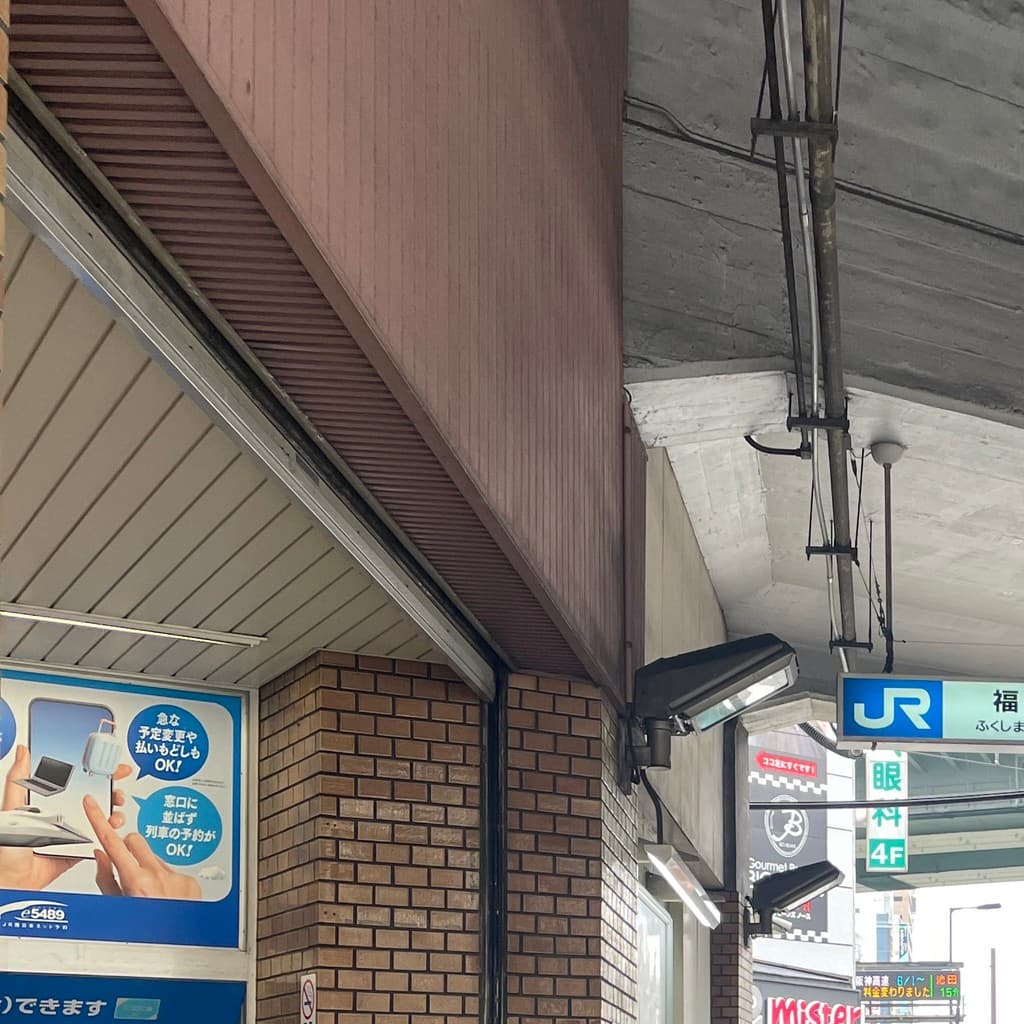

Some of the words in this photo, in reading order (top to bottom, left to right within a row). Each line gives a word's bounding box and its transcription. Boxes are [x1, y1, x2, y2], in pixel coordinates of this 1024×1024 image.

[853, 688, 931, 730] JR
[156, 712, 181, 727] 急な
[976, 720, 1024, 733] ふくしま
[138, 726, 198, 745] 予定変更や
[135, 741, 200, 760] 払いもどしも
[154, 758, 182, 773] OK!
[872, 749, 903, 828] 眼科
[164, 794, 198, 809] 窓口に
[162, 810, 197, 826] 並ばず
[145, 825, 216, 843] 列車の予約が
[166, 843, 194, 857] OK!
[871, 842, 904, 864] 4F
[21, 908, 65, 920] e5489
[863, 986, 931, 998] 料金変わりました
[0, 996, 107, 1017] )できます
